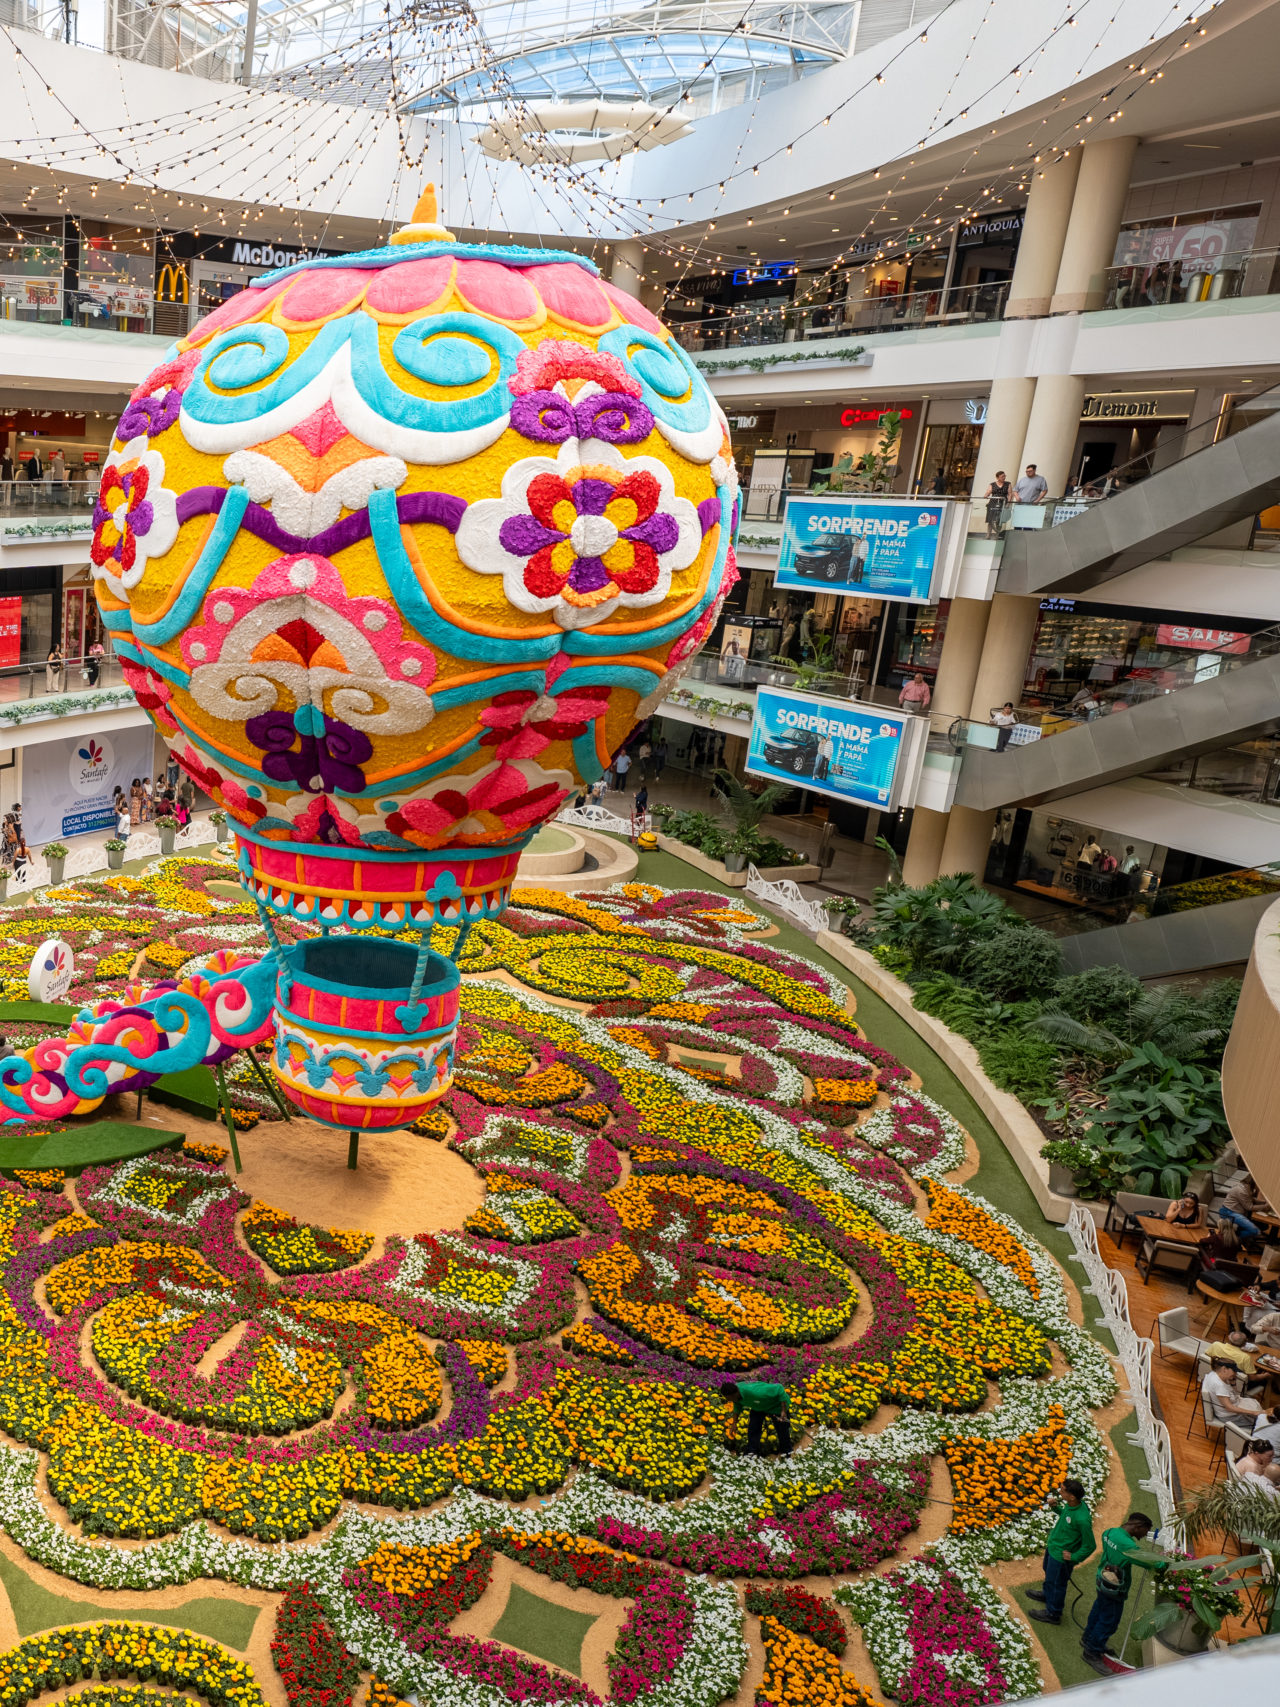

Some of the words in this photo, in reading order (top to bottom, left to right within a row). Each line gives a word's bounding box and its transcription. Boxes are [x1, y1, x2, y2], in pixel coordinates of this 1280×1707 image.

[231, 242, 330, 267] McDonal'
[1081, 396, 1158, 418] Clemont
[807, 514, 911, 538] SORPRENDE
[880, 547, 901, 557] PAPÁ
[882, 538, 907, 548] MAMÁ
[1171, 626, 1235, 648] SALE
[775, 708, 873, 745] SORPRENDE
[843, 750, 863, 762] PAPÁ
[845, 742, 869, 755] MAMÁ
[63, 815, 81, 827] LOCAL
[82, 809, 116, 822] DISPONIBLE
[63, 823, 87, 833] CONTACTO
